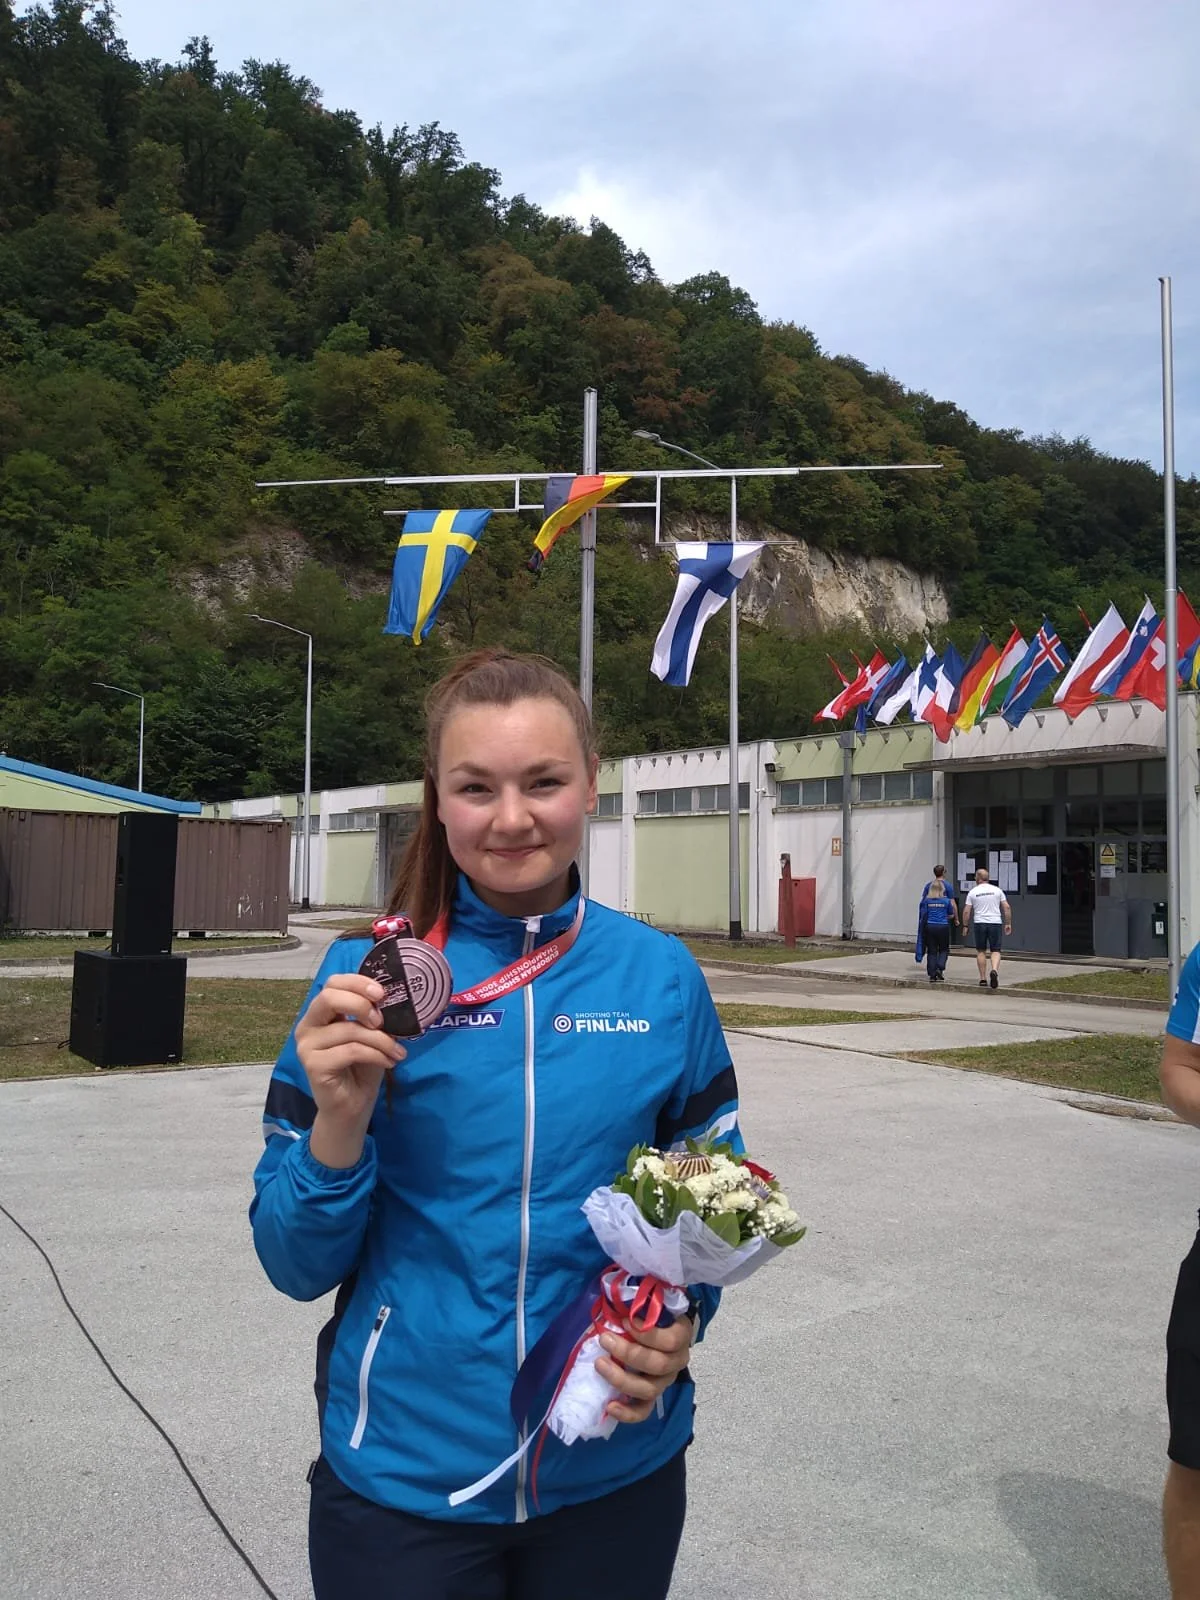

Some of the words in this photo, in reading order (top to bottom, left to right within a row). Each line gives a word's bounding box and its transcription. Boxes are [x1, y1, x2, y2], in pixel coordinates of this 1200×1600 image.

[499, 944, 558, 984] CHAMPIONSHIP
[520, 950, 559, 980] EUROPEAN
[409, 975, 422, 986] 20
[479, 975, 521, 999] SHOOTING
[412, 983, 424, 993] 22
[476, 982, 498, 995] 300M
[576, 1019, 650, 1033] FINLAND
